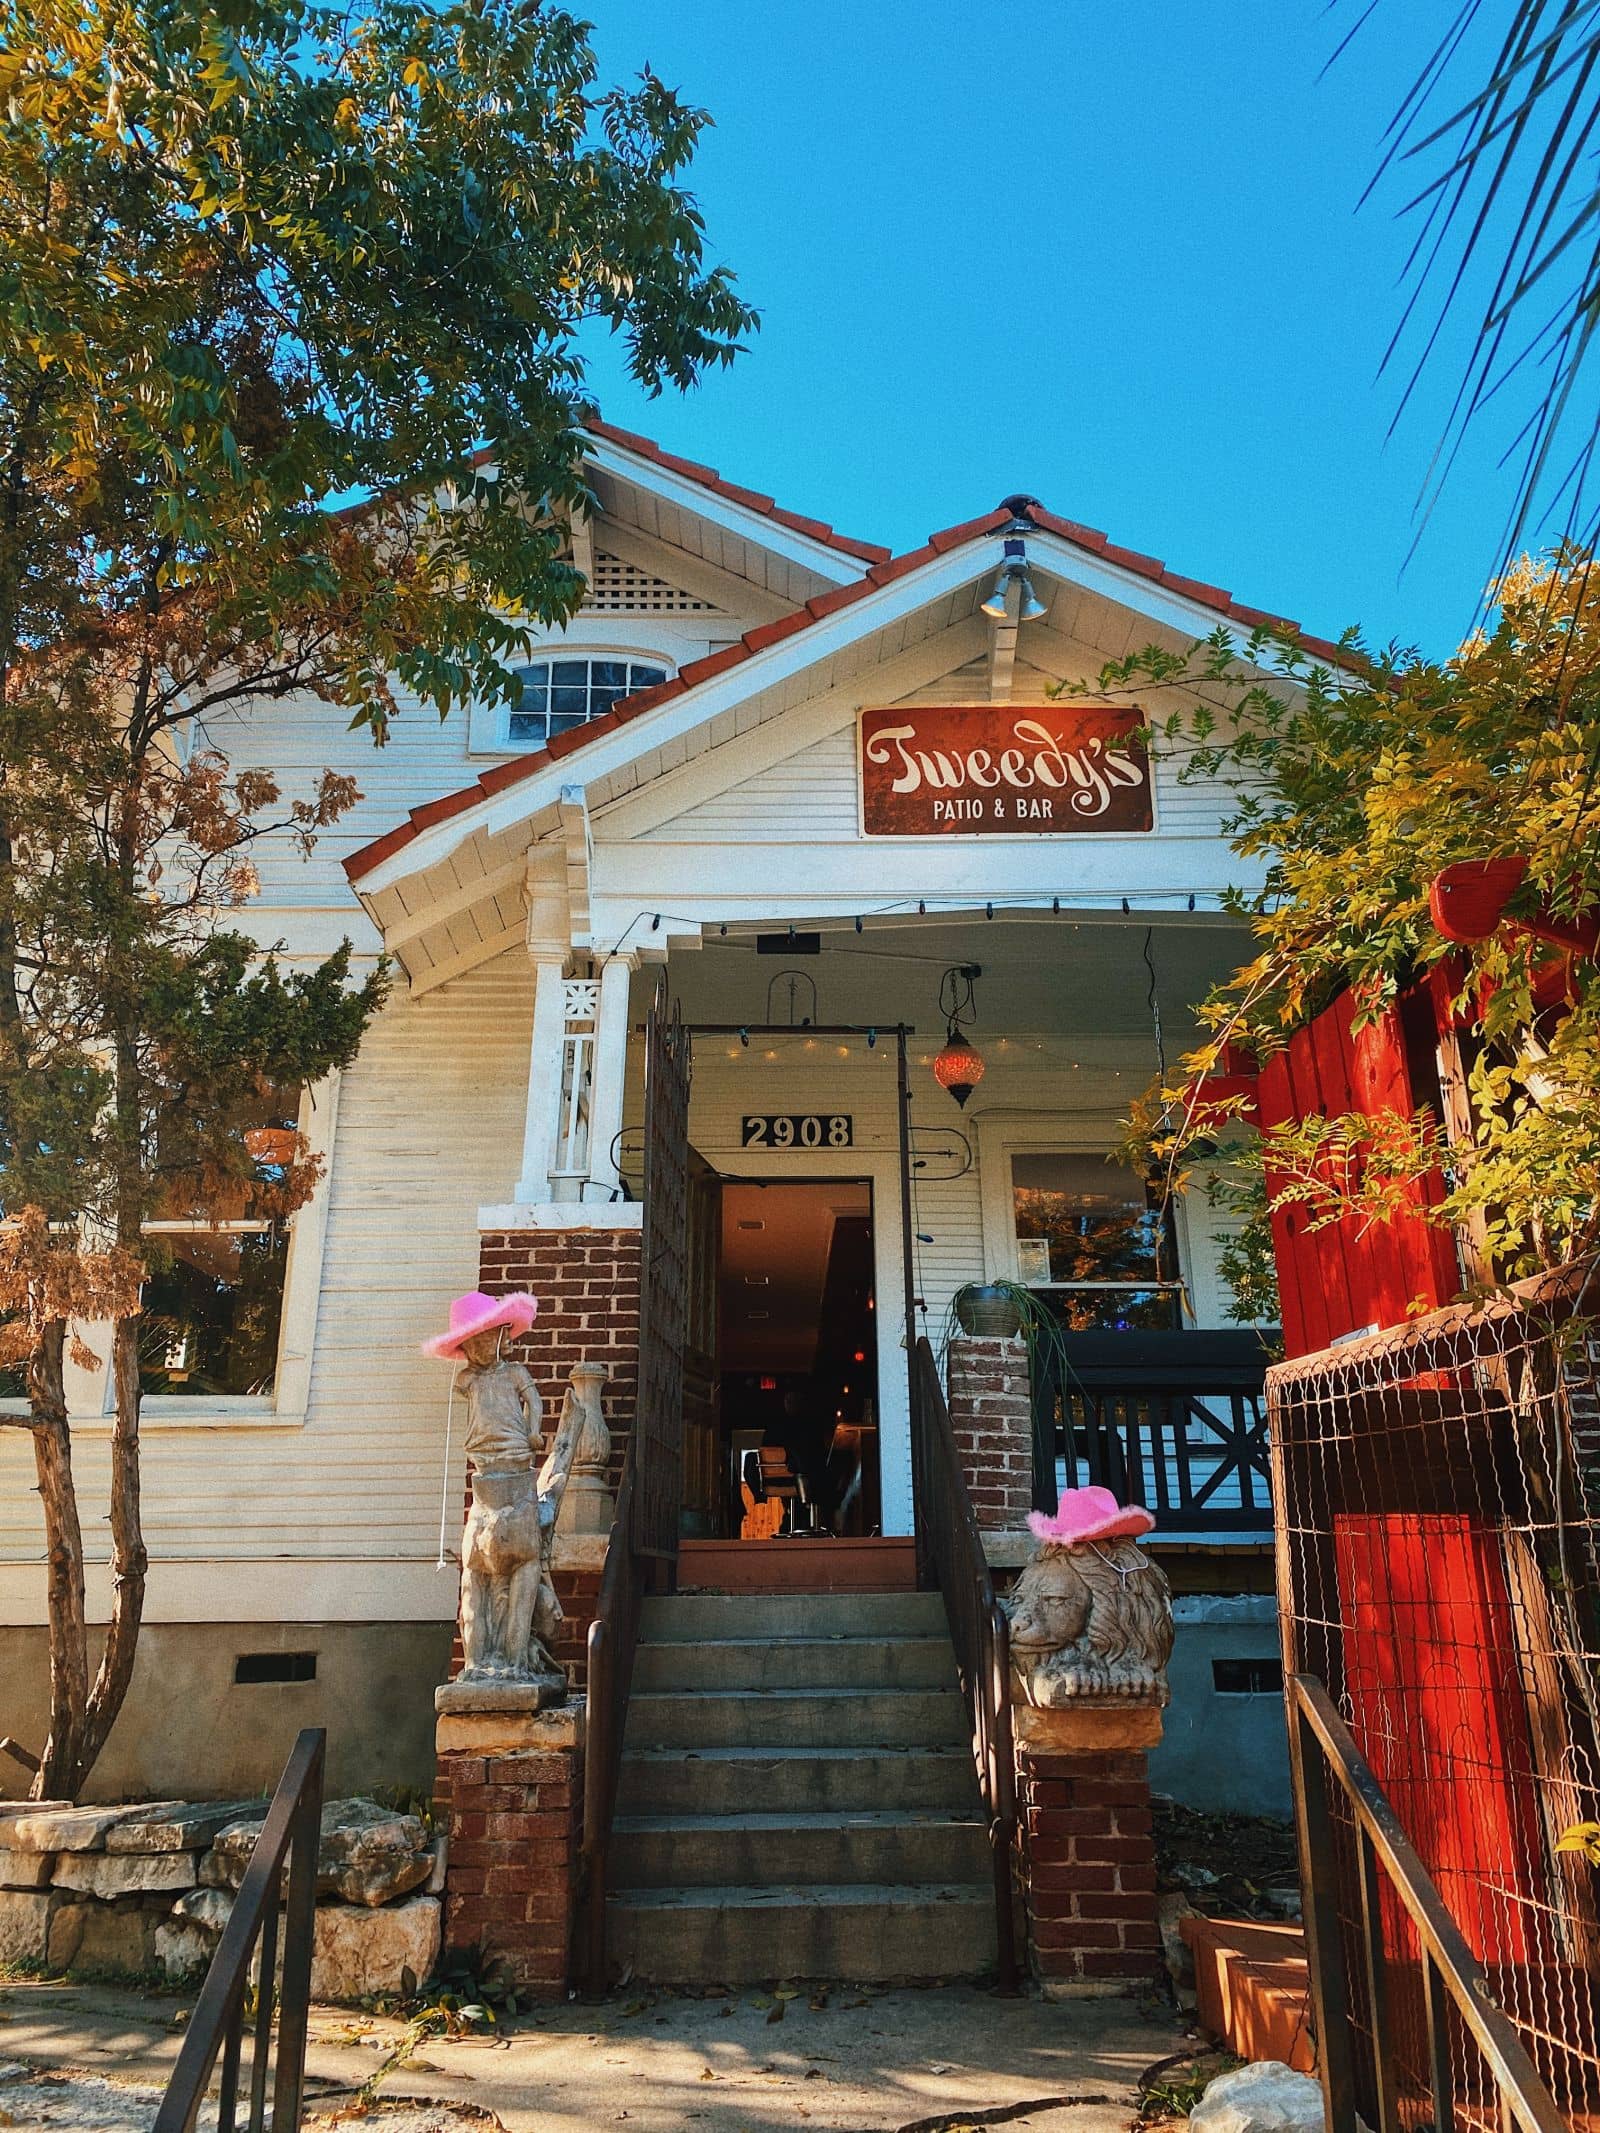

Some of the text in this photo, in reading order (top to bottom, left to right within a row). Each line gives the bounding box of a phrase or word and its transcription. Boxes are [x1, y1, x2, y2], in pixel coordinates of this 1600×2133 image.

[866, 719, 1144, 817] Tweedy's
[933, 798, 1053, 820] PATIO & BAR
[746, 1116, 849, 1147] 2908
